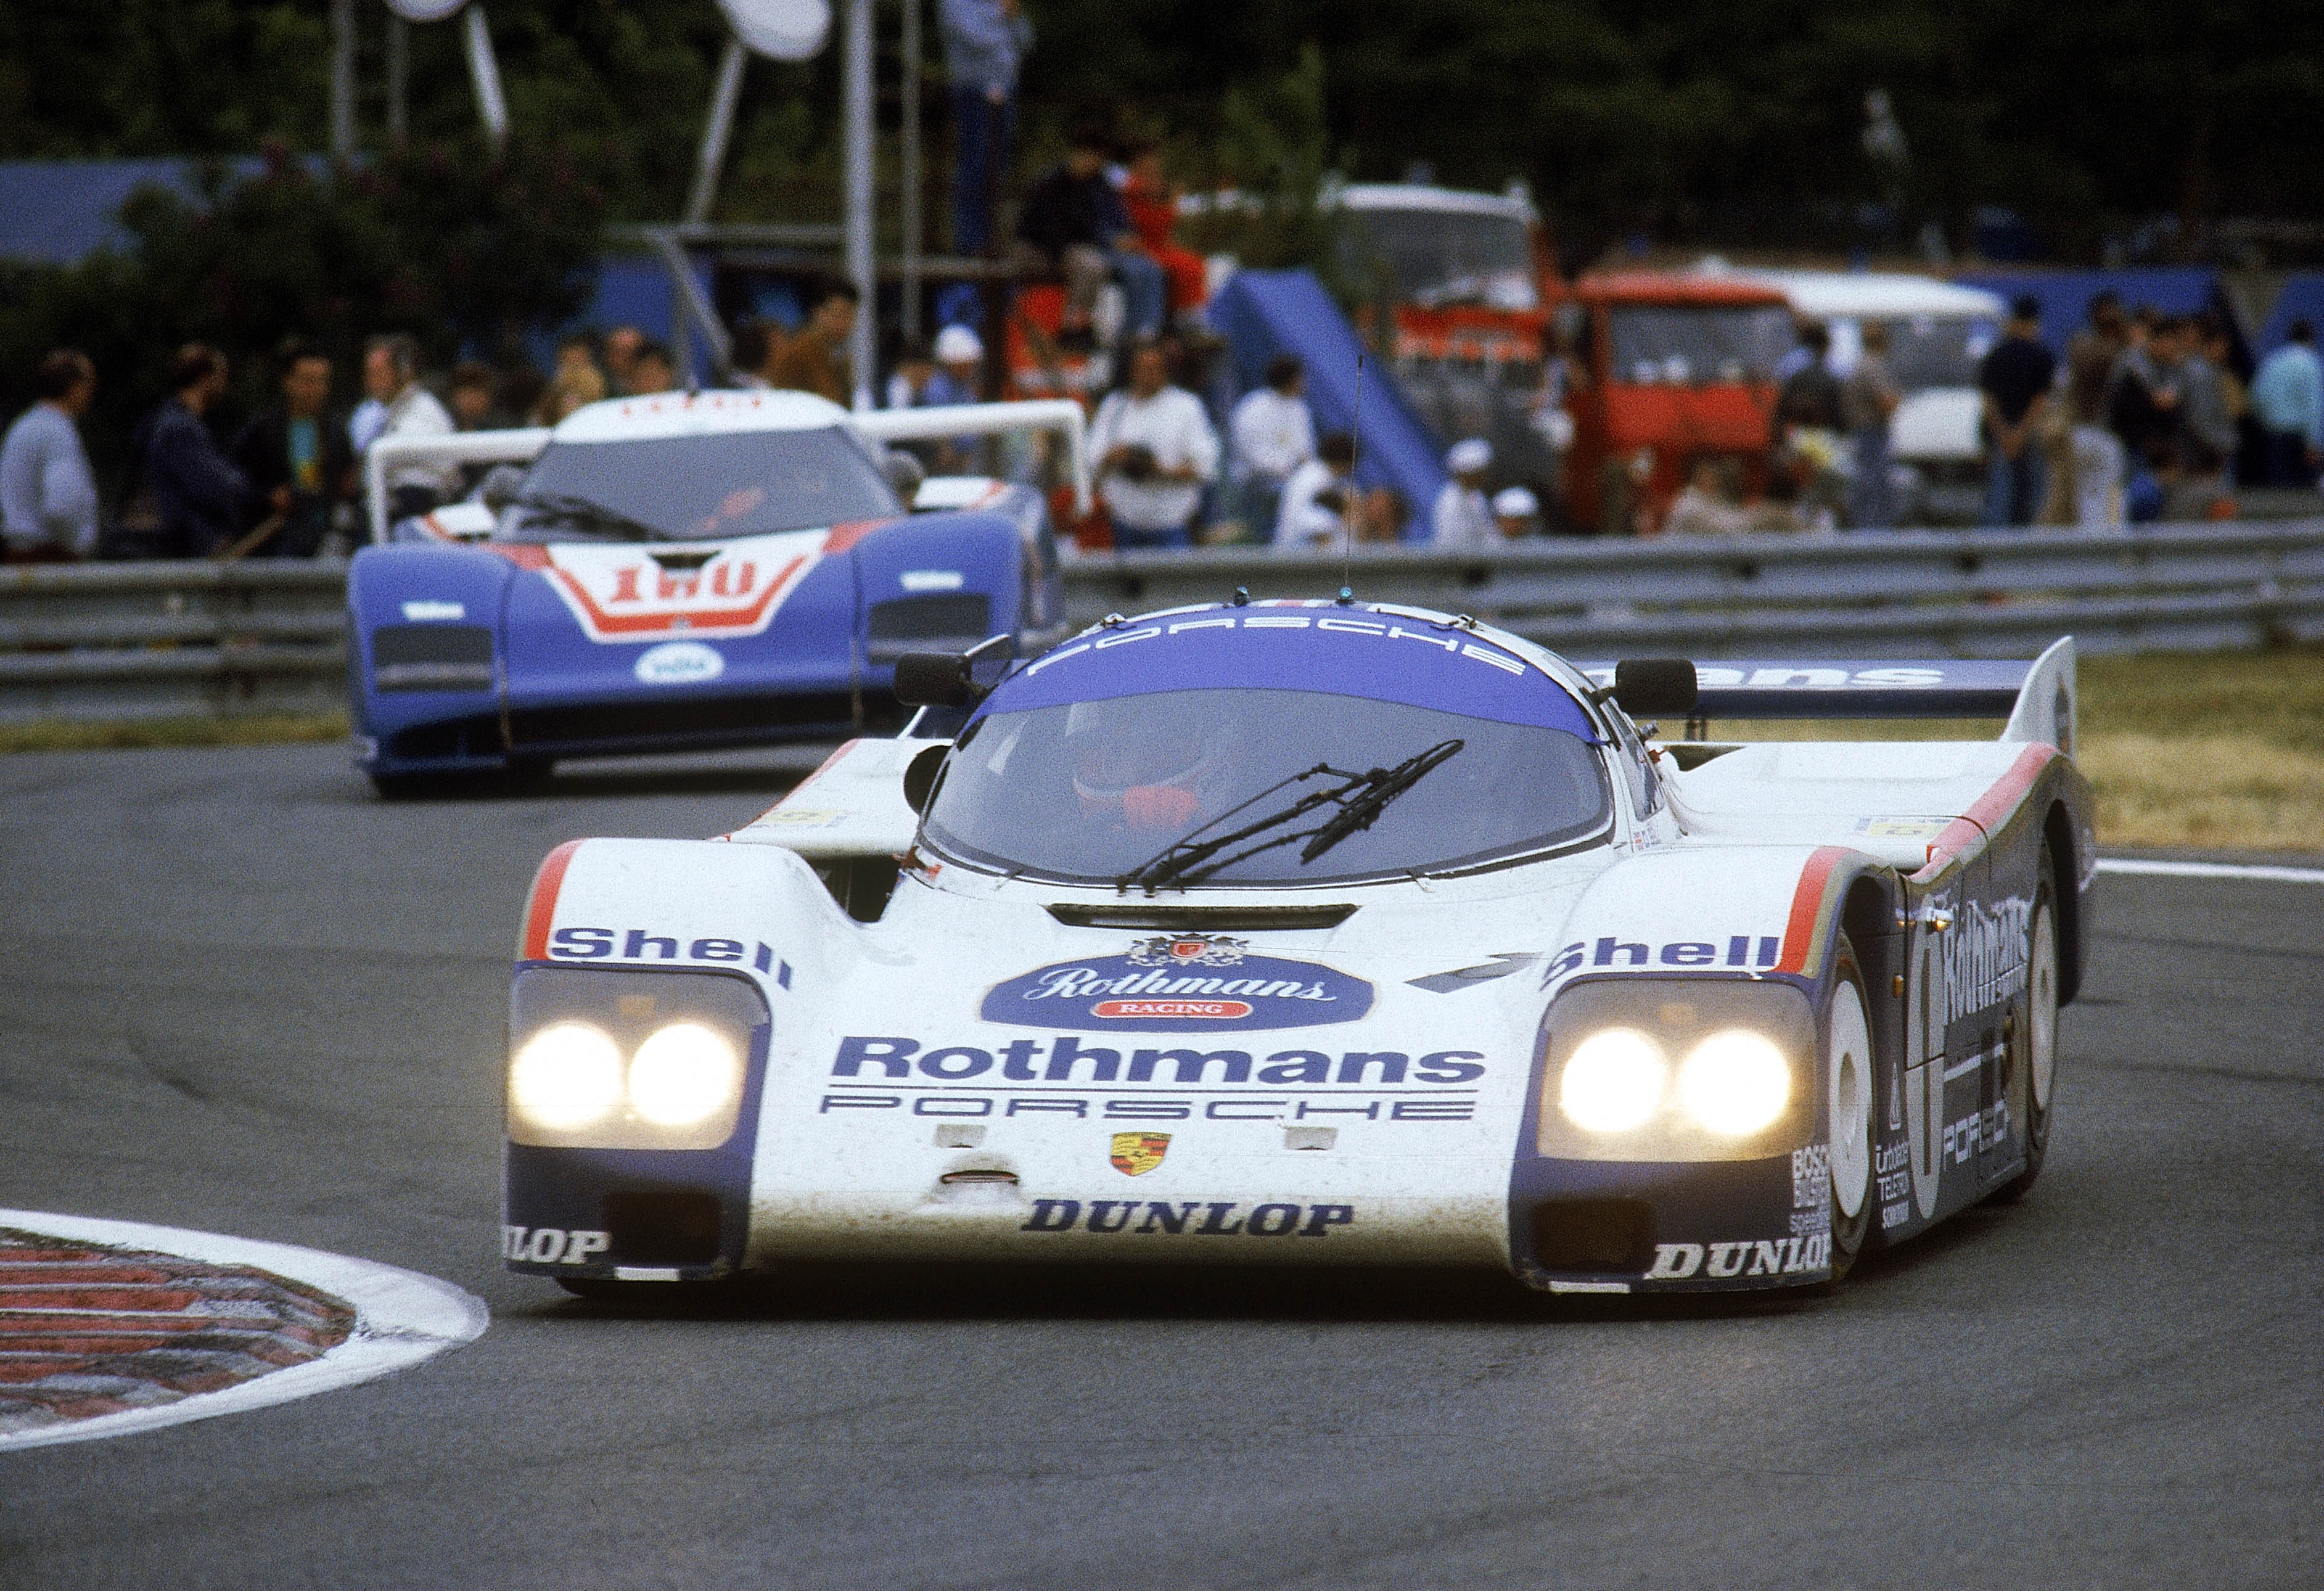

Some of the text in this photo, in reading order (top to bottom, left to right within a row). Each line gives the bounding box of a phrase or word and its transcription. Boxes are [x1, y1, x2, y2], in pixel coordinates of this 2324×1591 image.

[1027, 617, 1526, 676] PORSCHE
[551, 927, 794, 990] Shell
[1540, 935, 1781, 991] Shell
[1023, 968, 1337, 1001] Rothmans
[1117, 1003, 1224, 1015] RACING
[830, 1035, 1487, 1084] Rothmans
[821, 1095, 1476, 1121] PORSCHE
[1019, 1198, 1353, 1237] DUNLOP
[501, 1224, 612, 1264] LOP
